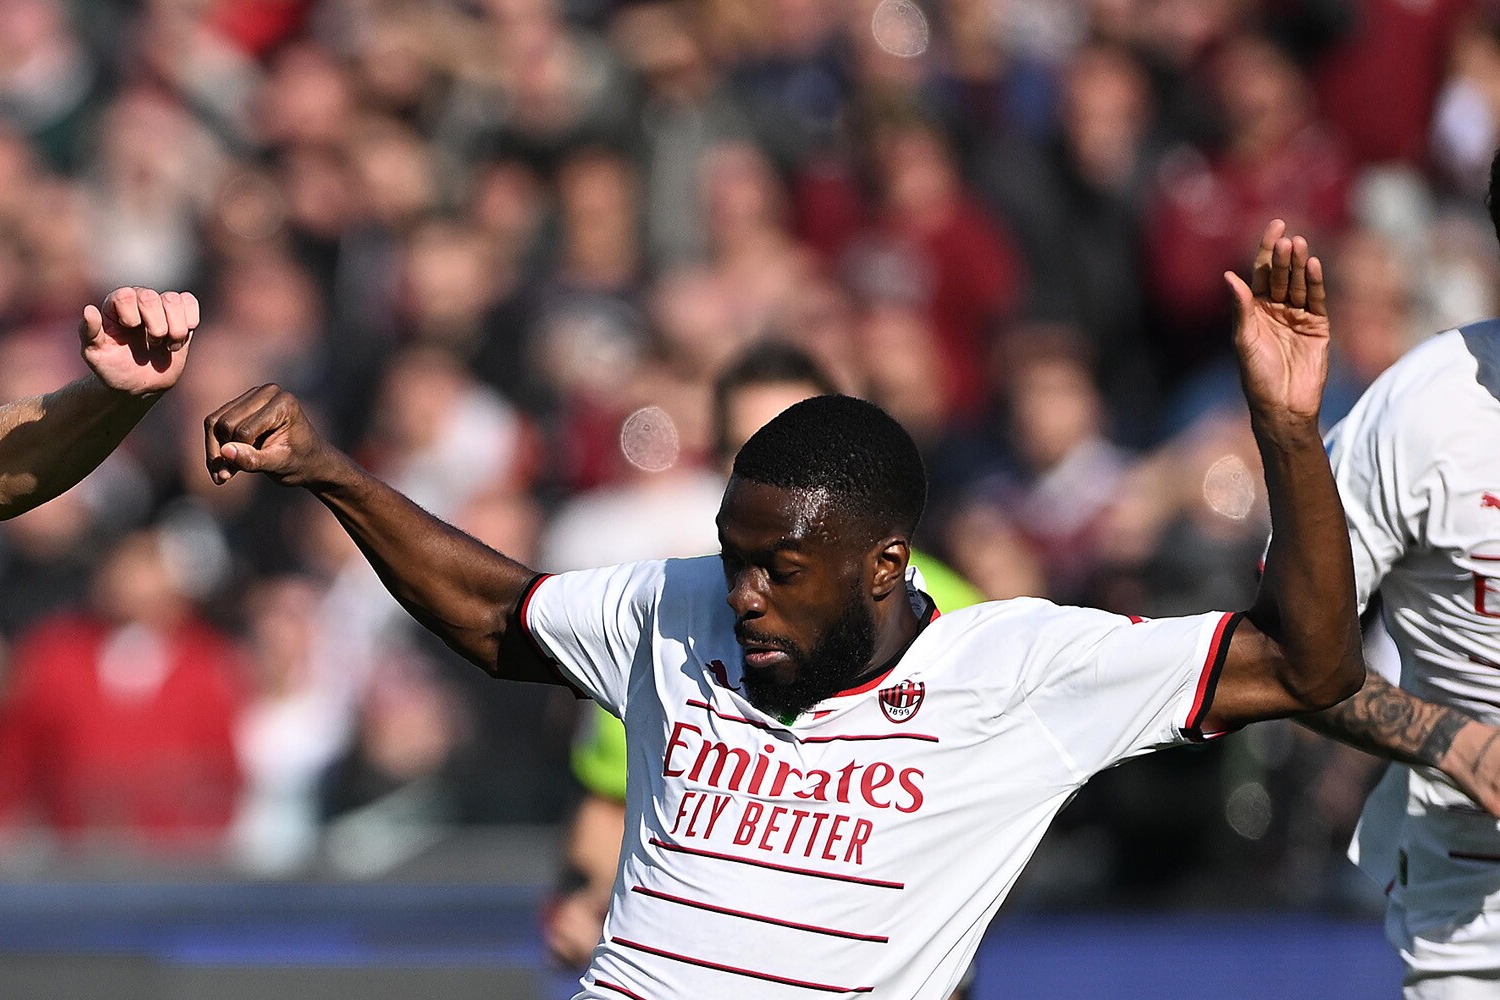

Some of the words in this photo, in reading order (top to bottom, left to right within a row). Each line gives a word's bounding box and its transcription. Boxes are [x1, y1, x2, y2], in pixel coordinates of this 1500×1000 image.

[889, 707, 910, 717] 1899
[663, 721, 925, 813] Emirates
[670, 791, 731, 840] FLY
[732, 799, 873, 865] BETTER
